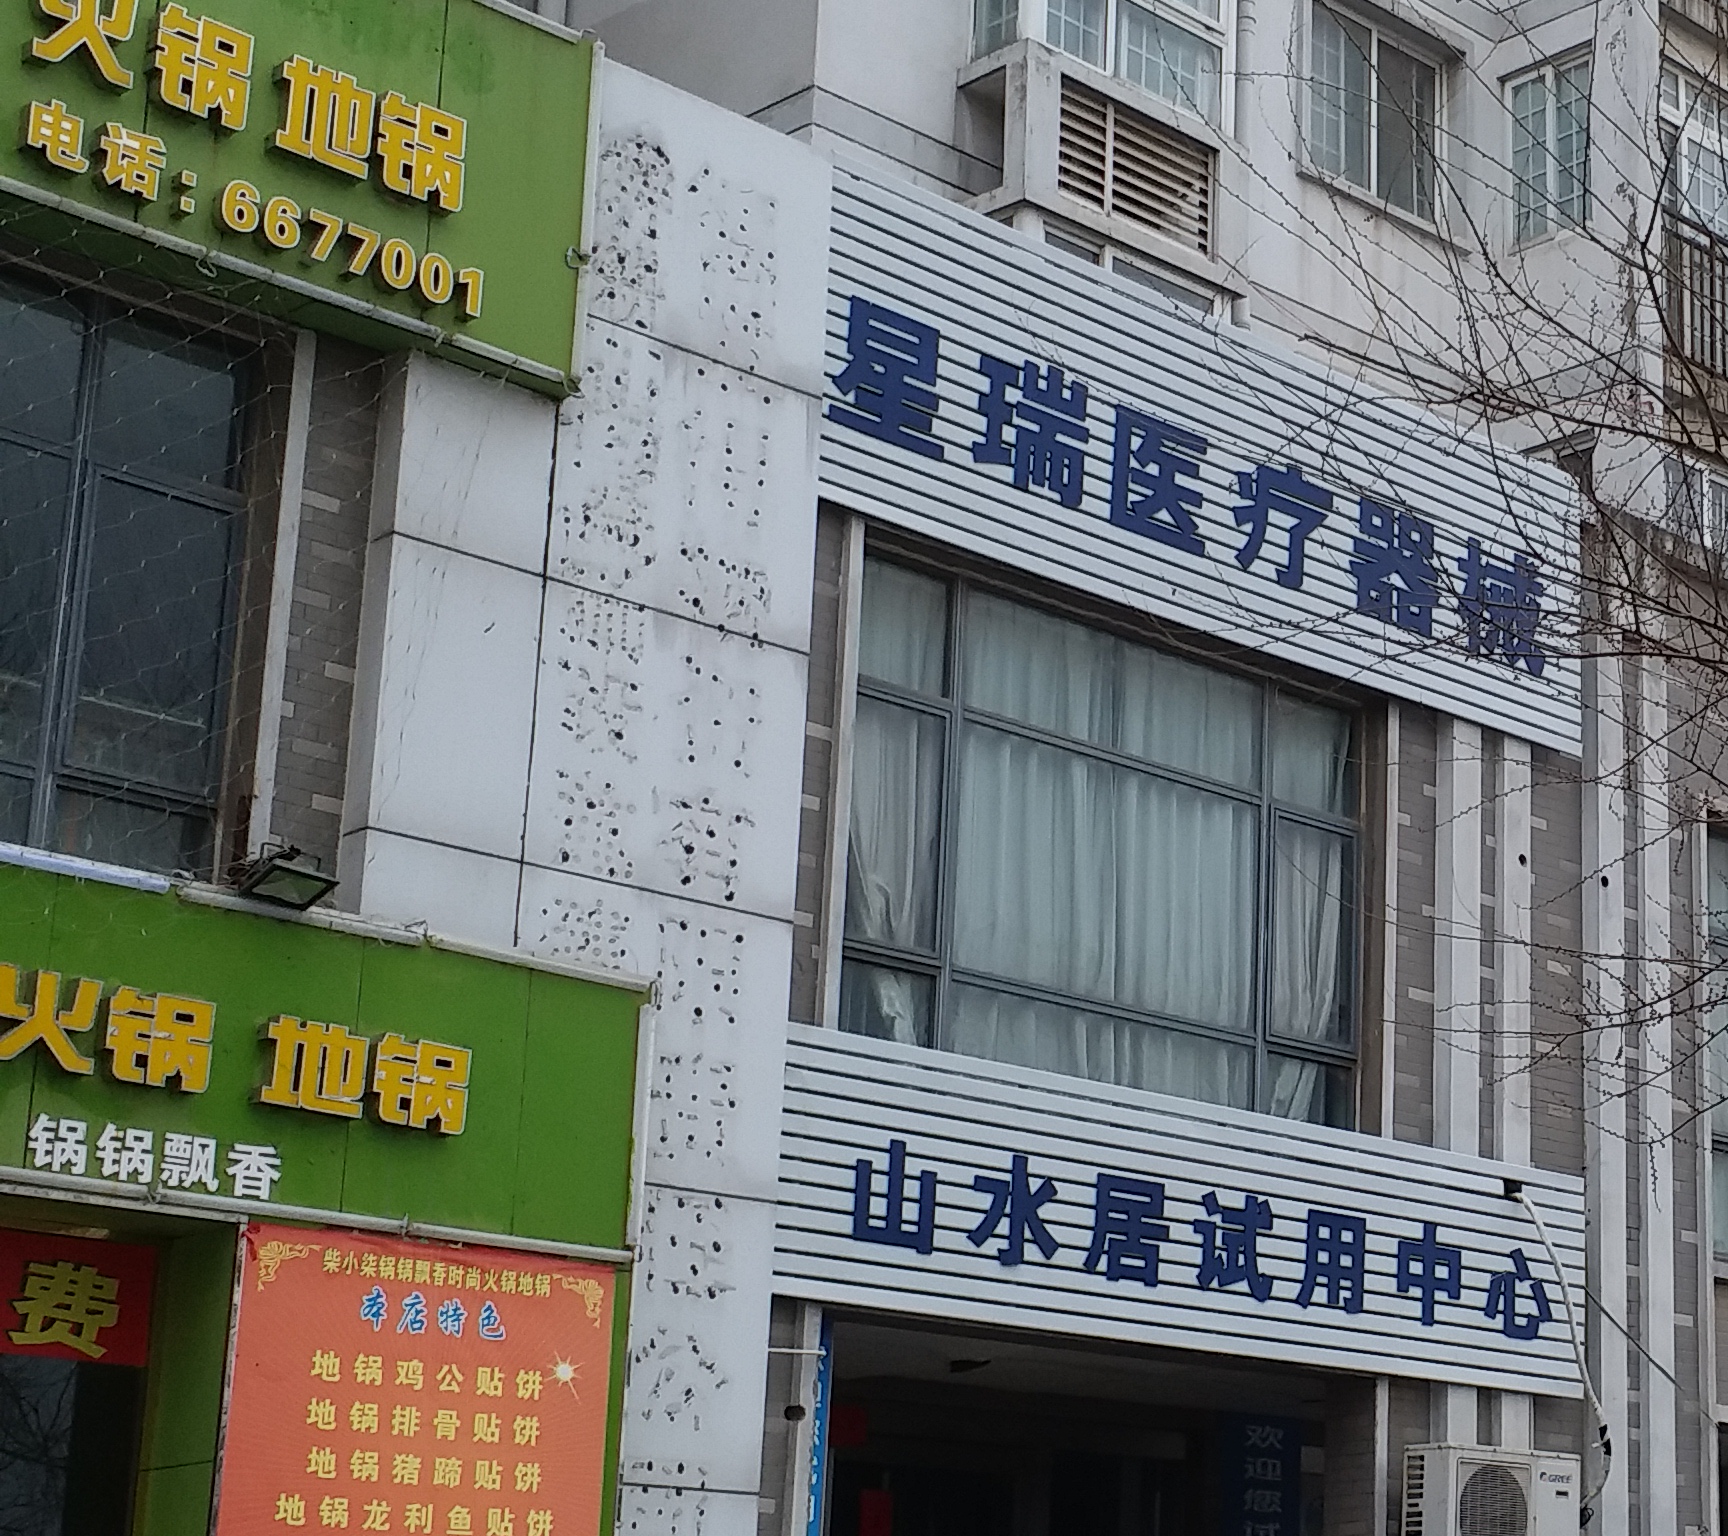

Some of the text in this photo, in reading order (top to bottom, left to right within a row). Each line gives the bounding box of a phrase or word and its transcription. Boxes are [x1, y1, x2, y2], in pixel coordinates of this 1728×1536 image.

[273, 54, 467, 213] 地锅
[829, 294, 1545, 676] 星瑞医疗器械
[0, 962, 473, 1136] 火锅 地锅
[28, 1112, 282, 1201] 锅锅飘香
[322, 1247, 551, 1298] 柴小柒锅锅飘香时尚火锅地锅
[852, 1139, 1551, 1342] 山水居试用中心
[7, 1261, 122, 1358] 费
[359, 1285, 507, 1341] 本店特色
[311, 1350, 543, 1402] 地锅鸡公贴饼
[307, 1398, 541, 1448] 地锅排骨贴饼
[305, 1447, 543, 1494] 地锅猪蹄贴饼
[1548, 1474, 1572, 1483] GREE
